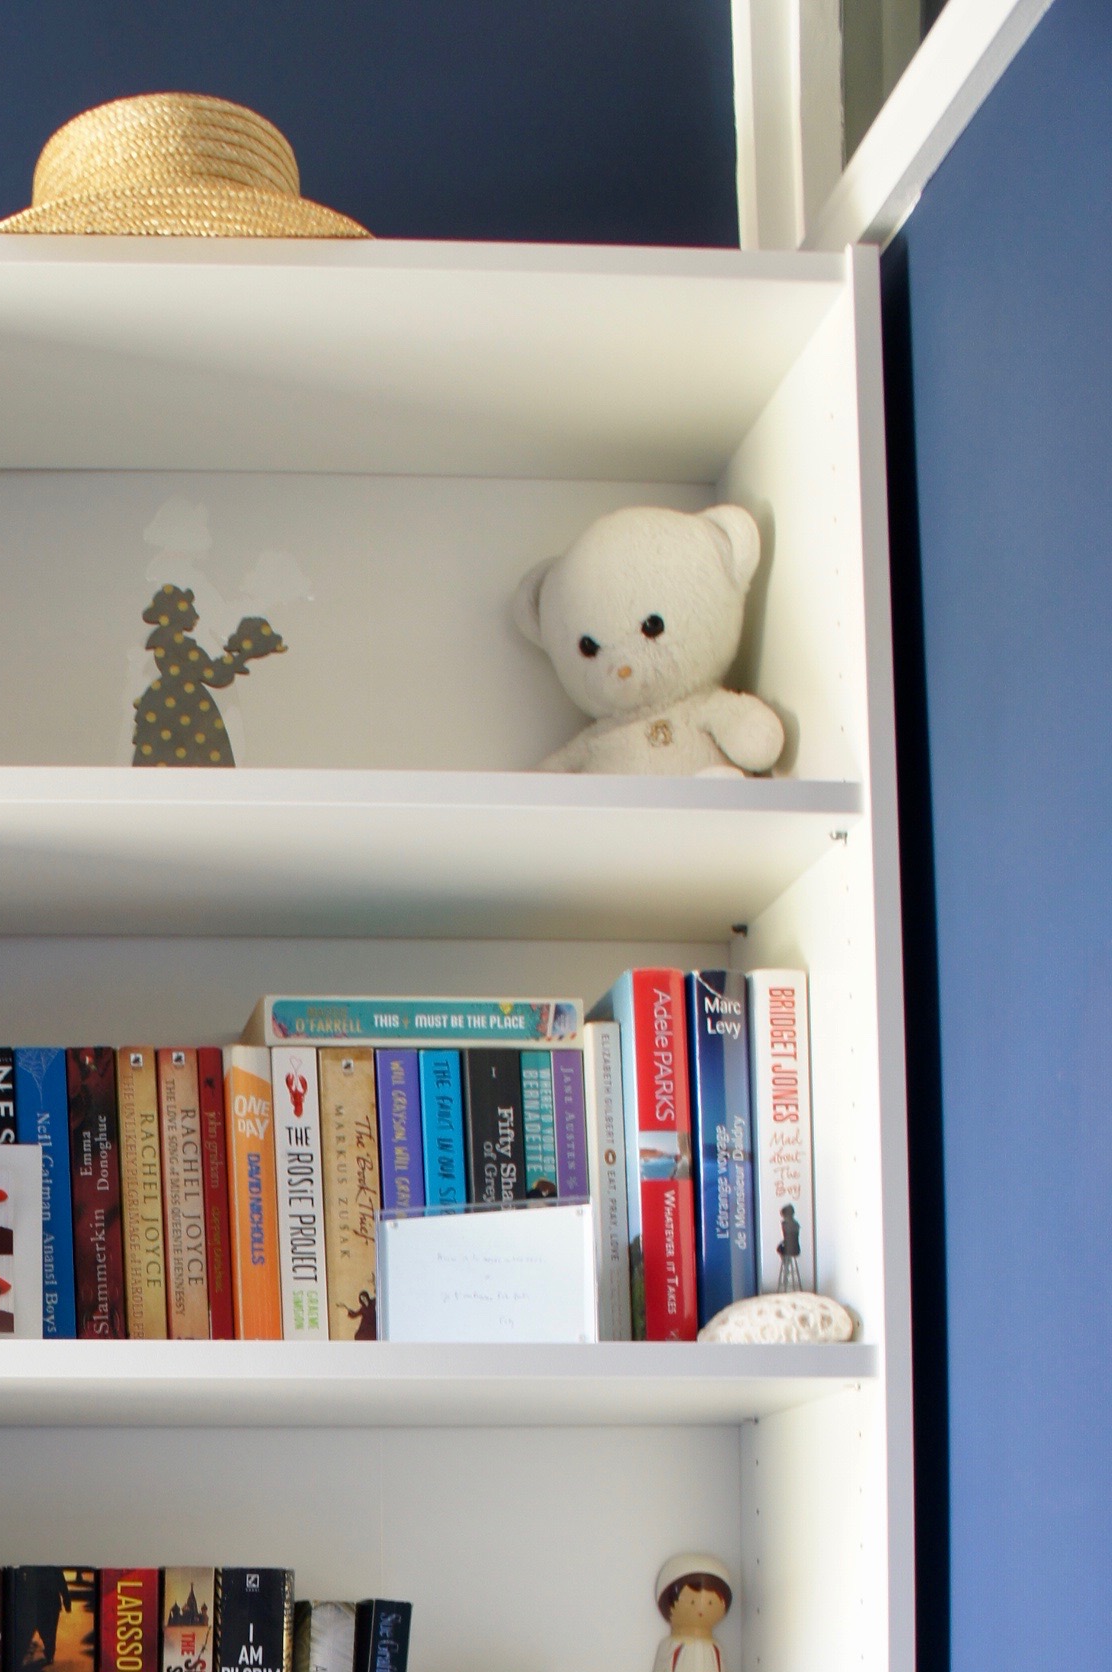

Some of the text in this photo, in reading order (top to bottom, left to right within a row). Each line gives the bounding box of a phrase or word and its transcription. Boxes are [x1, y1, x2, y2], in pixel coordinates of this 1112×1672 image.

[374, 1013, 526, 1030] THIS MUST BE THE PLACE
[704, 996, 741, 1015] Marc
[706, 1017, 742, 1040] Levy
[652, 987, 675, 1122] Adele PARKS
[768, 987, 800, 1123] BRIDGET JONES
[234, 1094, 270, 1116] ONE
[238, 1117, 271, 1140] DAY
[80, 1130, 92, 1176] Emma
[95, 1114, 113, 1191] Donoghue
[140, 1113, 162, 1288] RACHEL JOYCE
[286, 1125, 318, 1283] THE ROSIE PROJECT
[335, 1104, 351, 1260] MARKUS ZUSAK
[38, 1113, 59, 1334] Neil Gaiman Anansi Boys
[90, 1208, 110, 1335] Slammerkin
[181, 1632, 196, 1656] THE
[238, 1645, 264, 1666] AM
[248, 1623, 254, 1642] I
